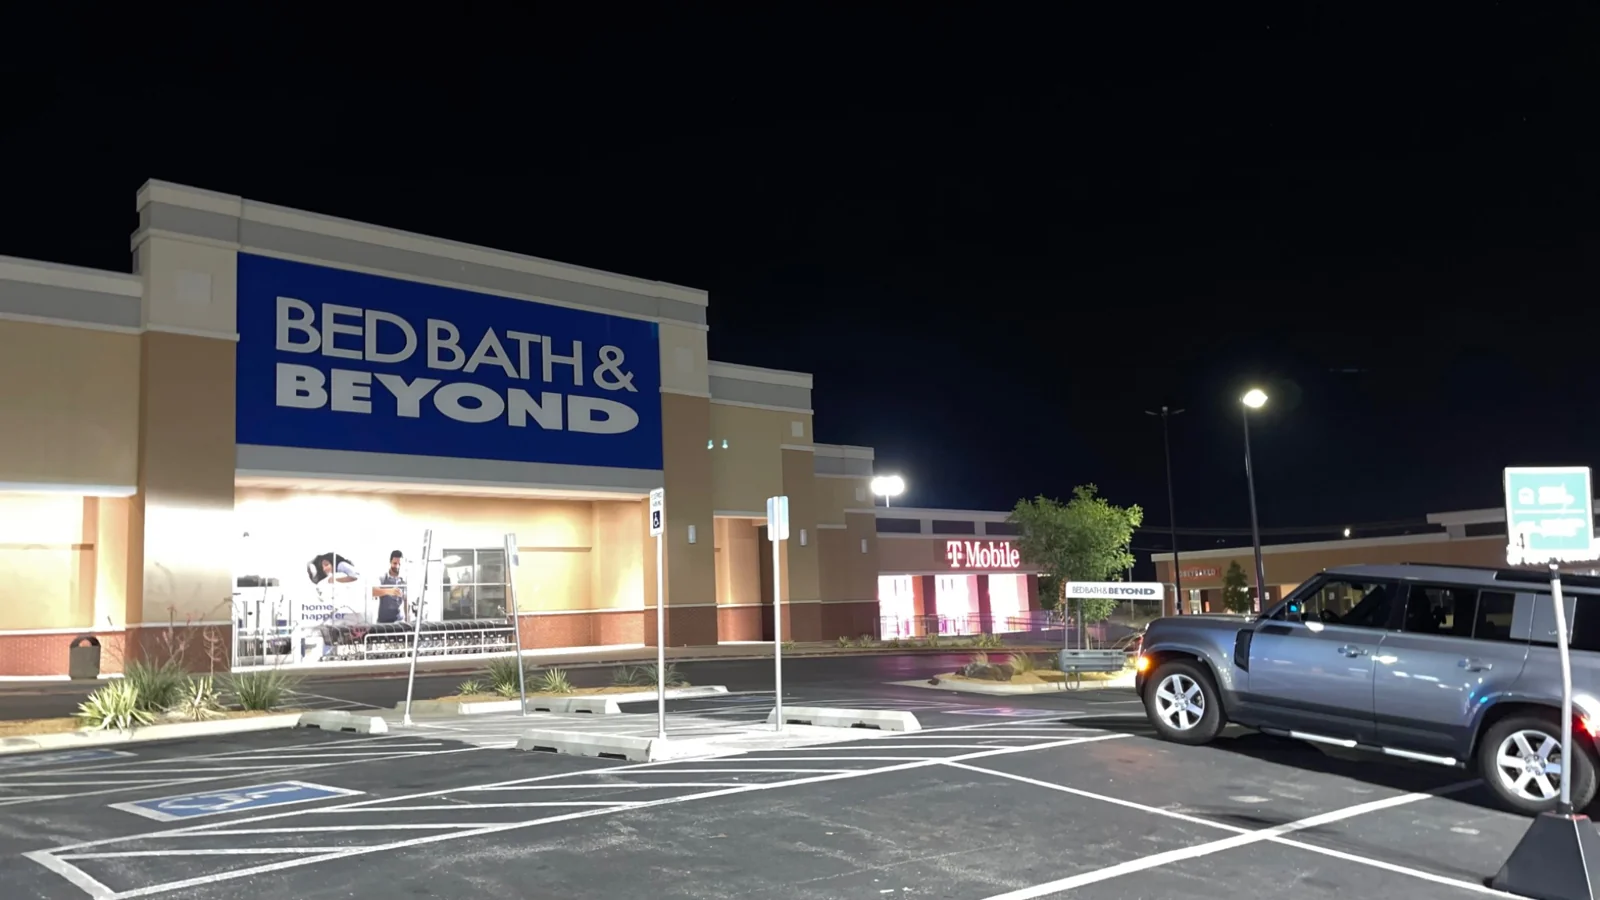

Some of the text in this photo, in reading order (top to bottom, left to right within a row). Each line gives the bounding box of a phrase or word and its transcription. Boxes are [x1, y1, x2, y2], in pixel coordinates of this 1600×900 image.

[275, 296, 639, 393] BED BATH &
[275, 362, 639, 435] BEYOND
[1108, 587, 1156, 596] BEYOND
[301, 612, 345, 621] happier
